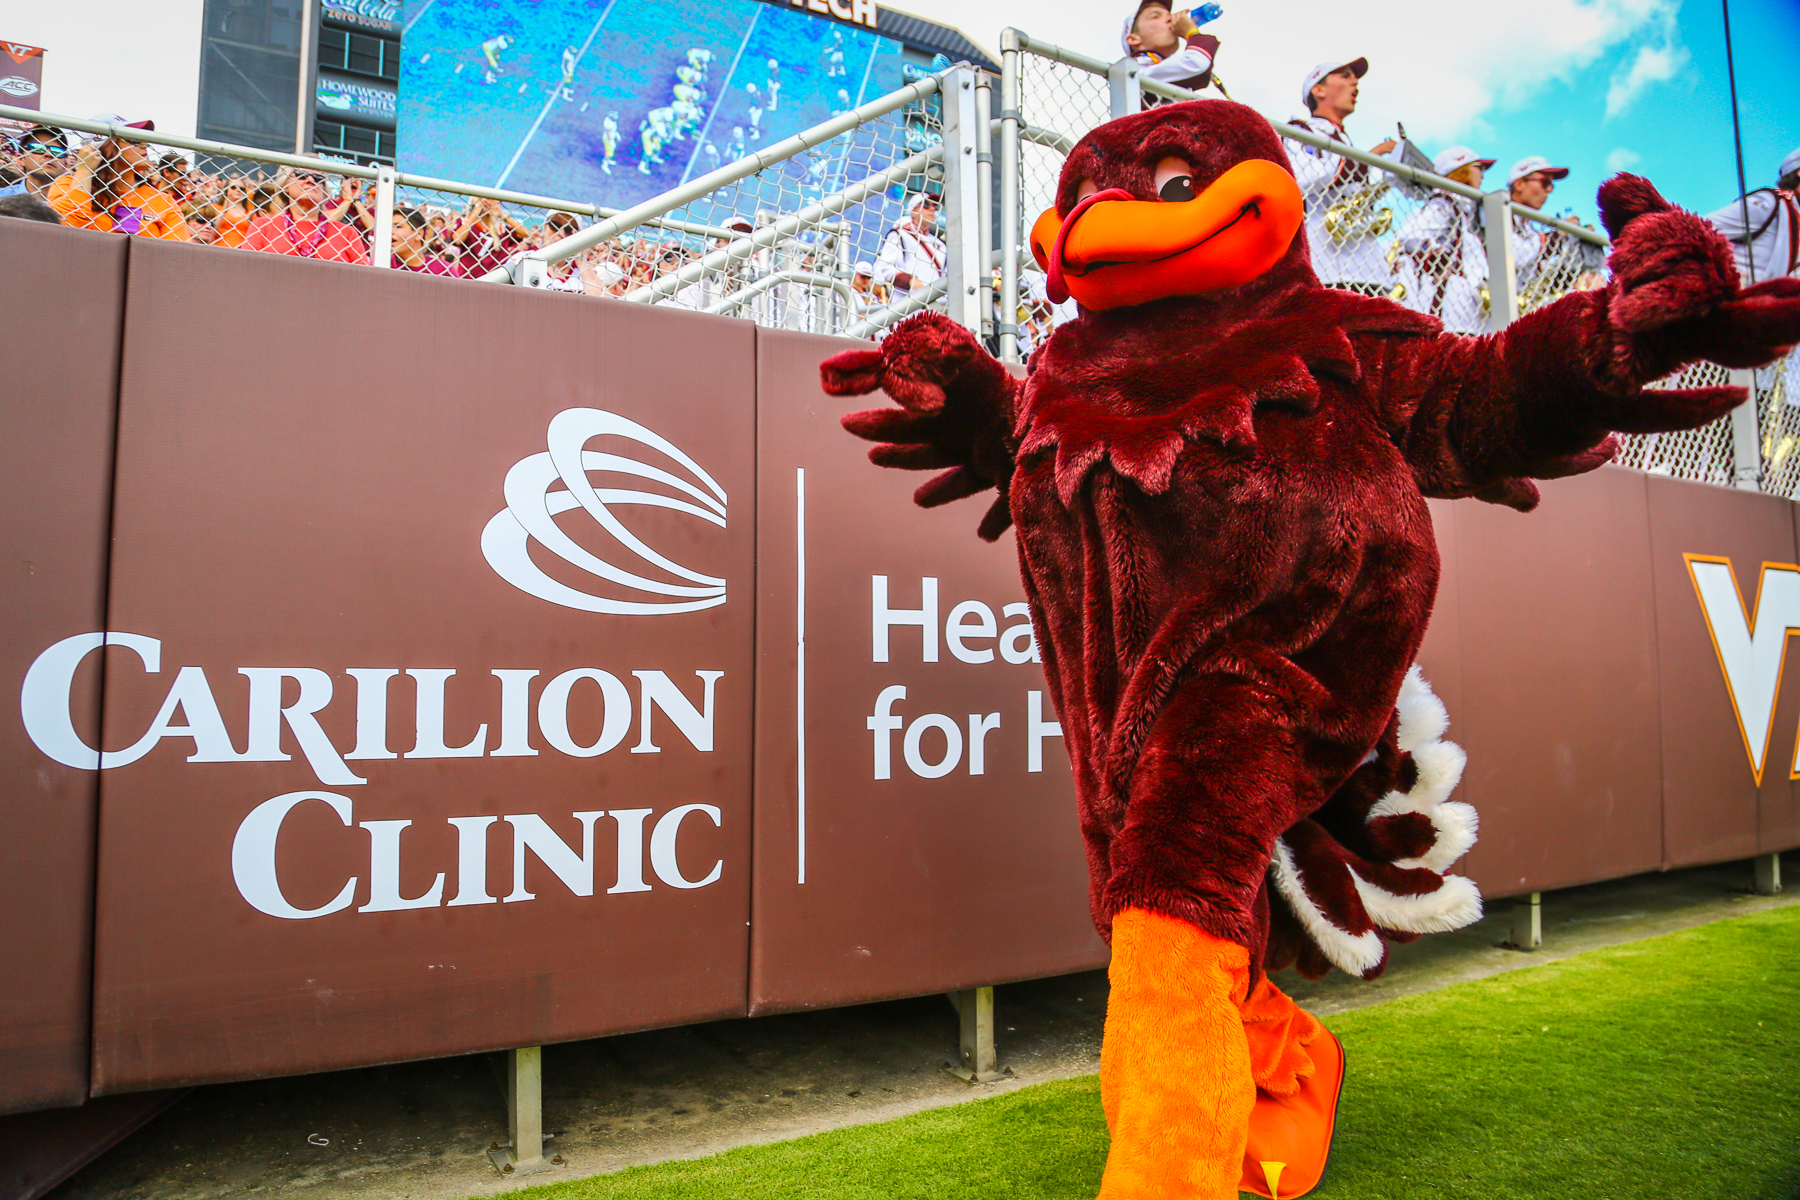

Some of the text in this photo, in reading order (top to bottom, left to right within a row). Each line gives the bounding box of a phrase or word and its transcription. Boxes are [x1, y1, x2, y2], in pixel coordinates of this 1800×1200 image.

[6, 43, 34, 57] VT
[2, 80, 34, 91] ACC
[322, 79, 396, 102] HOMEWOOD
[358, 96, 396, 112] SUITES
[21, 631, 725, 786] CARILION
[867, 684, 1001, 780] for
[231, 790, 724, 919] CLINIC
